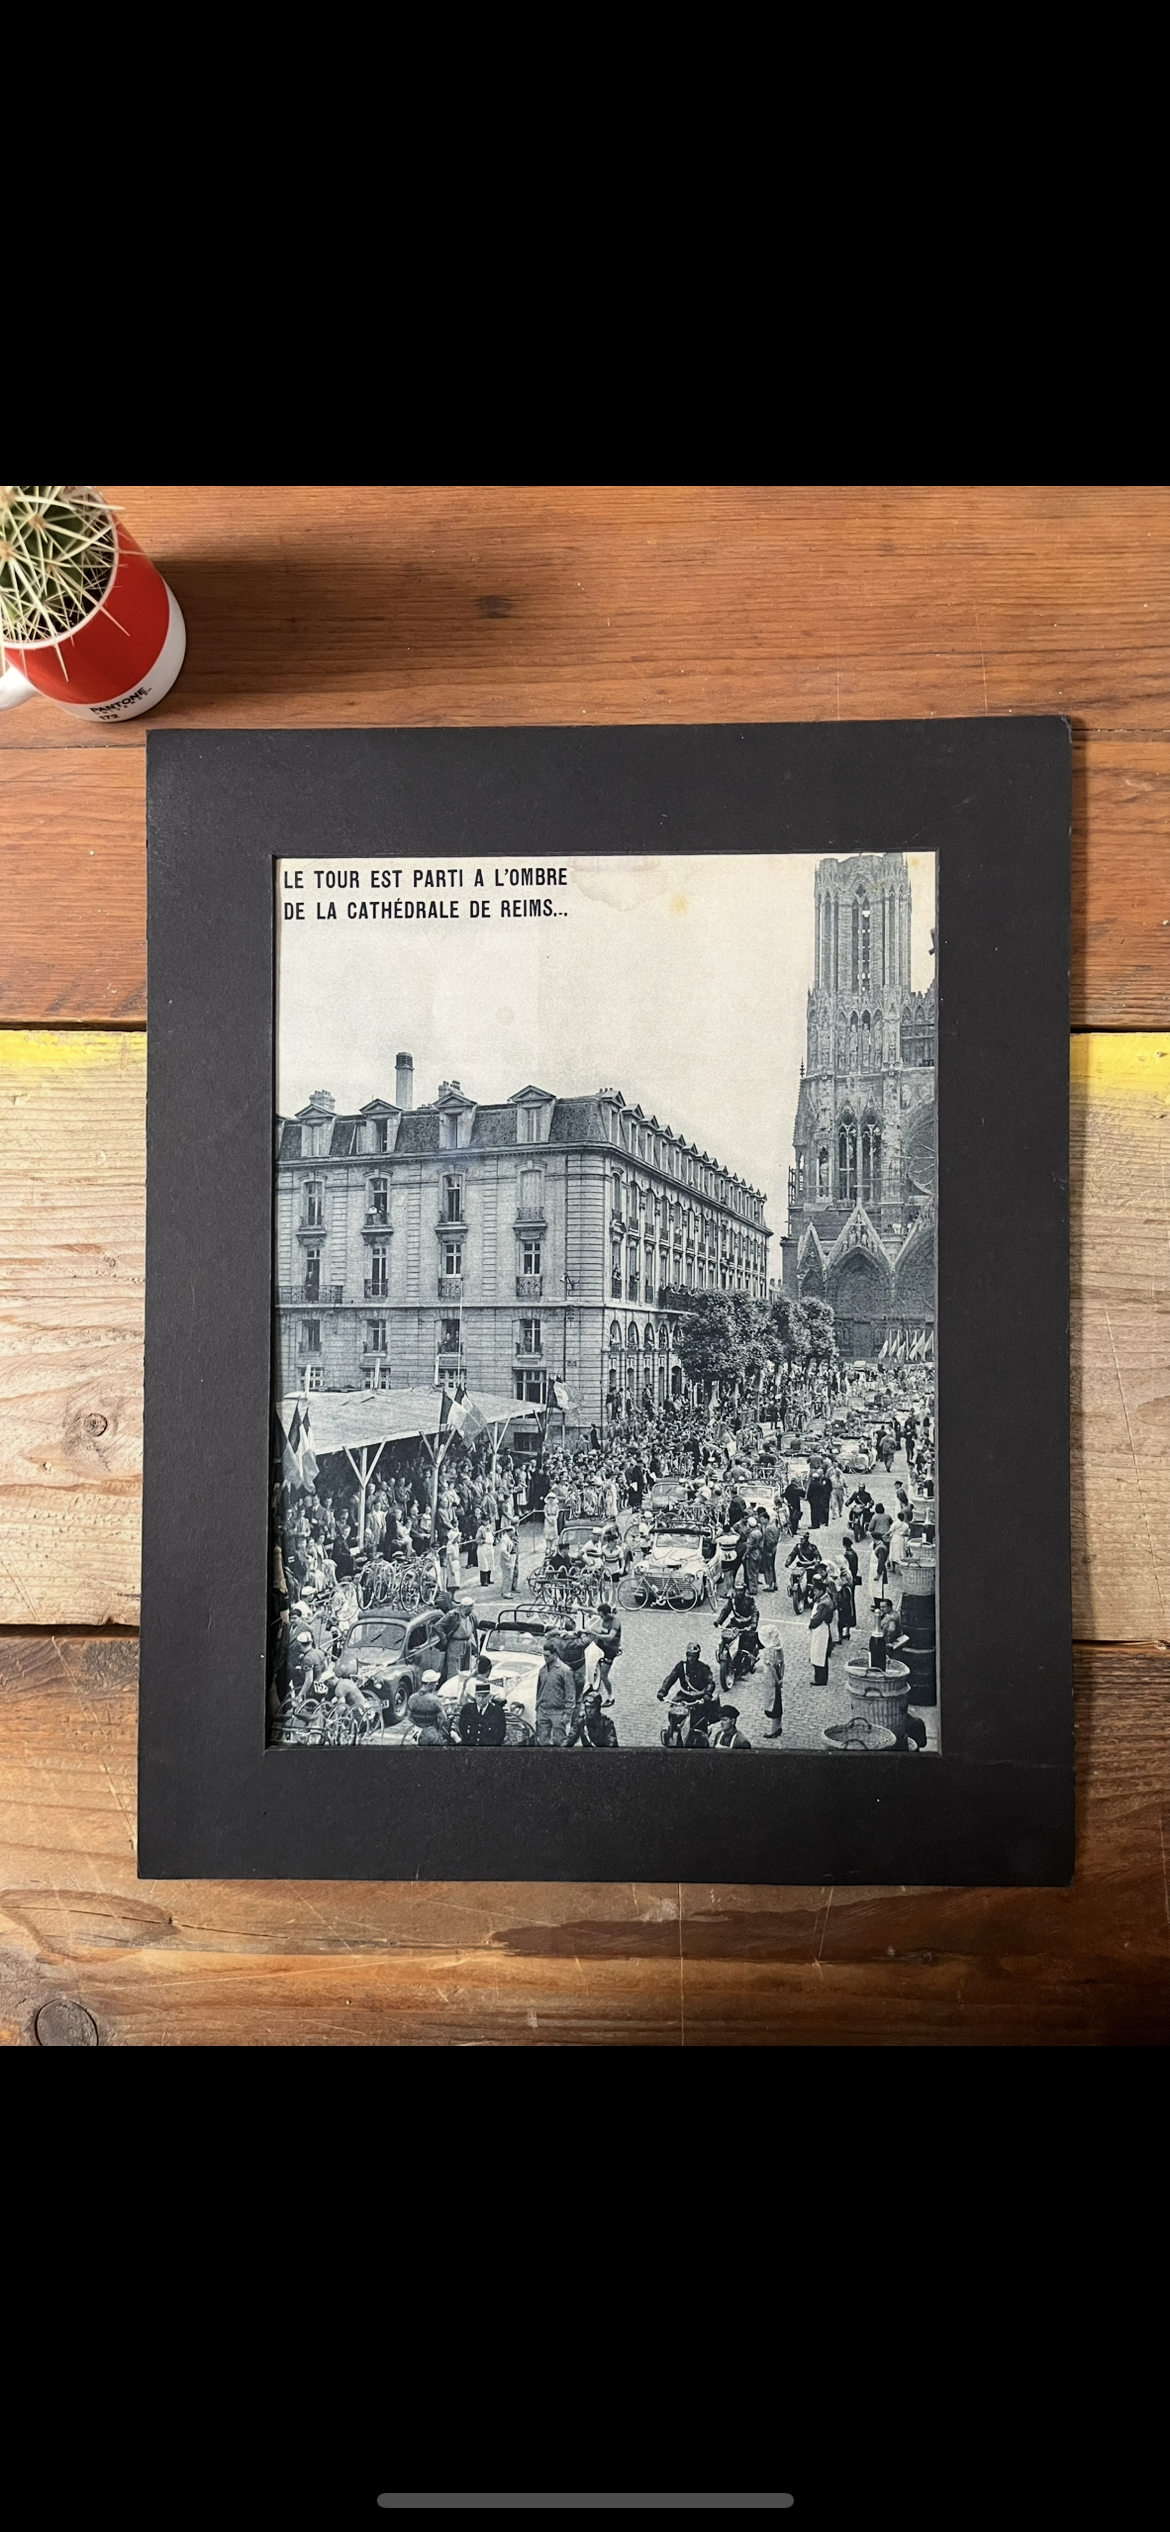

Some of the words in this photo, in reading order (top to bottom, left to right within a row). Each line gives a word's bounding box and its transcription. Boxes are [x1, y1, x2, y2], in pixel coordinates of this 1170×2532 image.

[89, 687, 145, 713] PANTONE
[284, 870, 304, 889] LE
[314, 870, 360, 889] TOUR
[371, 870, 403, 888] EST
[413, 869, 463, 888] PARTI
[474, 868, 485, 887] A
[495, 867, 568, 886] L’OMBRE
[284, 902, 305, 920] DE
[316, 902, 337, 920] LA
[347, 898, 459, 920] CATHÉDRALE
[470, 900, 491, 918] DE
[501, 899, 568, 918] REIMS...
